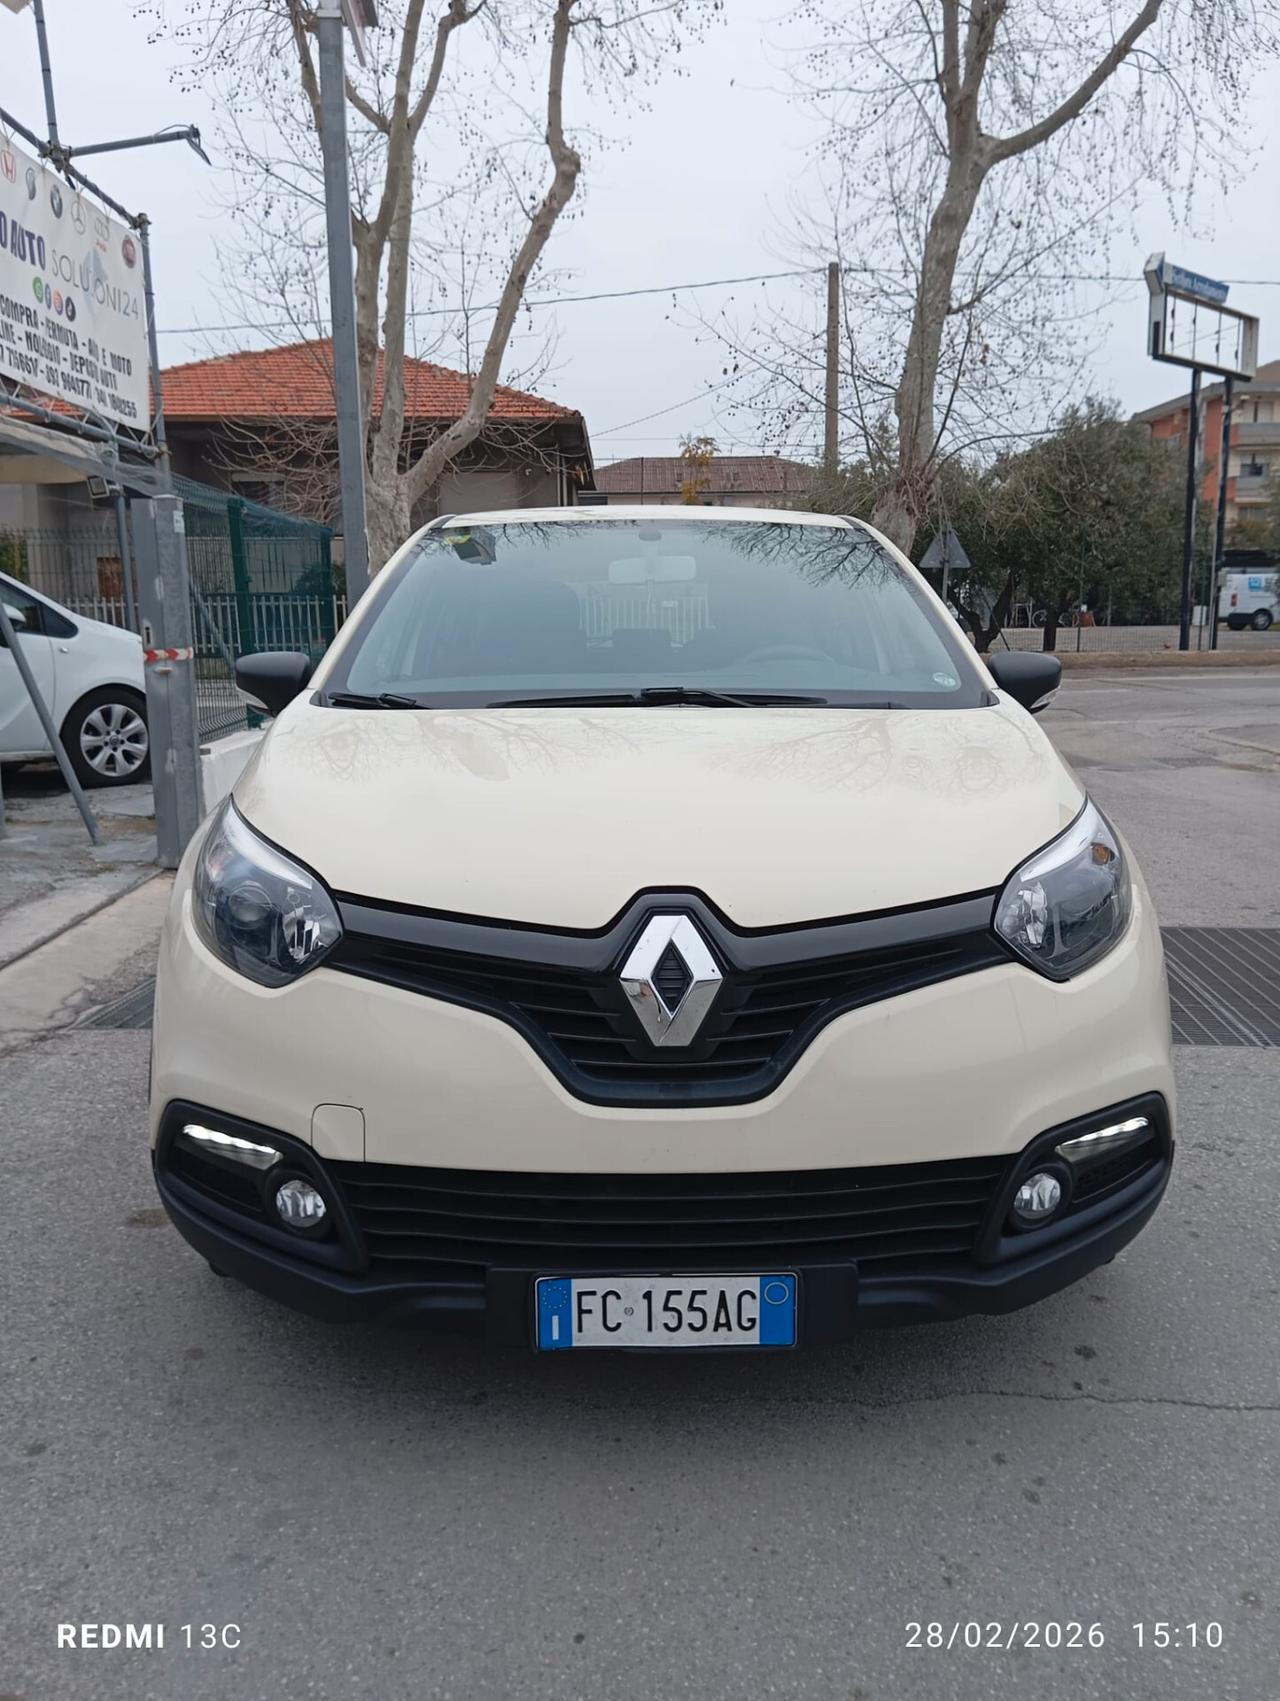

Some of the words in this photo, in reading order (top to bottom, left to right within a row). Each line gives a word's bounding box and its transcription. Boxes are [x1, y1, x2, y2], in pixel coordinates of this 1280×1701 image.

[11, 219, 46, 271] AUTO
[0, 293, 39, 330] COMPRA
[577, 1290, 622, 1333] FC
[643, 1289, 757, 1332] 155AG
